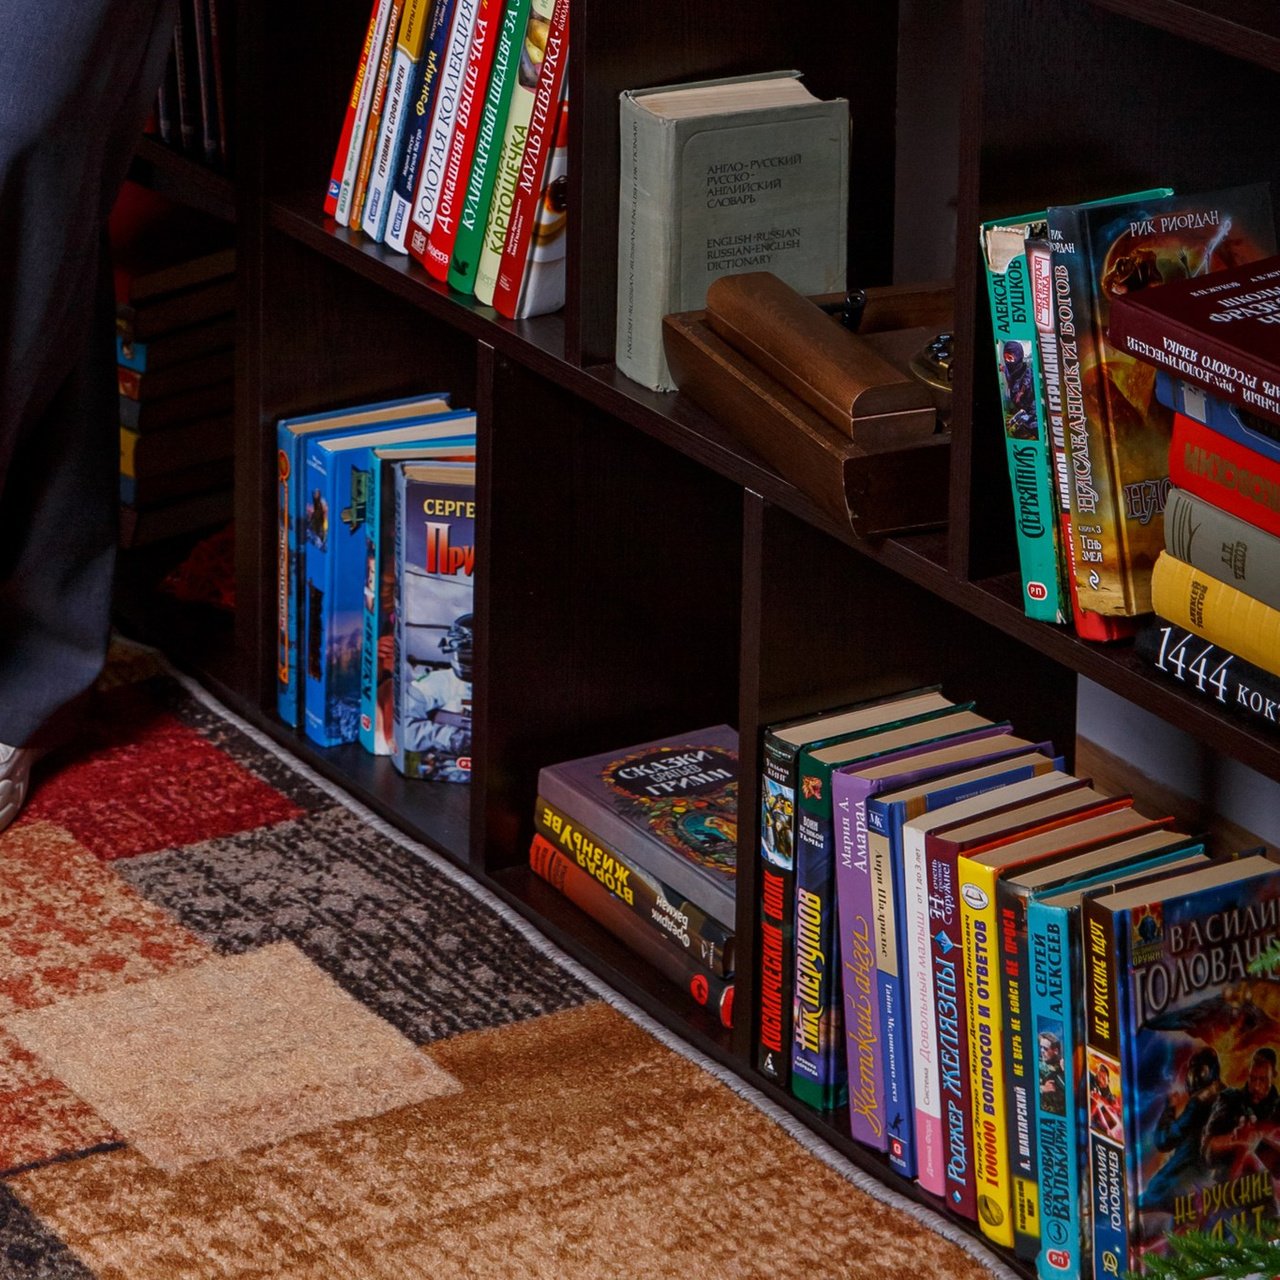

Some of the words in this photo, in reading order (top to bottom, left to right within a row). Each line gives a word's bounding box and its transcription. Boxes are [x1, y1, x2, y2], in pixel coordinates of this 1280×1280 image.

[394, 64, 406, 93] ЛОРЕН
[389, 95, 401, 125] СОФИ
[418, 129, 448, 226] ЗОЛОТАЯ
[438, 0, 474, 128] КОЛЛЕКЦИЯ
[462, 105, 498, 230] КУЛИНАРНЫЙ
[489, 33, 509, 108] ШЕДЕВР
[504, 10, 518, 35] ЗА
[519, 36, 562, 195] МУЛЬТИВАРКА
[378, 136, 392, 179] ГОТОВИМ
[707, 153, 802, 175] АНГЛО-РУССКИЙ
[707, 170, 756, 187] РУССКО-
[436, 132, 466, 235] Домашняя
[490, 124, 528, 256] КАРТОШЕЧКА
[706, 178, 782, 198] АНГЛИЙСКИЙ
[706, 193, 756, 209] СЛОВАРЬ
[706, 227, 801, 249] ENGLISH-RUSSIAN
[1129, 218, 1158, 238] РИК
[1161, 210, 1220, 235] РИОРДАН
[706, 239, 801, 261] RUSSIAN-ENGLISH
[706, 253, 773, 272] DICTIONARY
[1008, 260, 1027, 324] БУШКОВ
[1035, 256, 1044, 323] СЕКРЕТНАЯ
[1041, 274, 1050, 311] ПАПКА
[1054, 265, 1076, 337] БОГОВ
[1163, 336, 1198, 362] ЯЗЫКА
[1040, 333, 1062, 412] ГЕРМАНИИ
[1201, 356, 1257, 389] РУССКОГО
[1060, 337, 1099, 514] НАСЛЕДНИКИ
[1081, 551, 1103, 562] ЗМЕЯ
[1190, 580, 1201, 625] АЛЕКСЕЙ
[1197, 584, 1208, 629] ТОЛСТОЙ
[1155, 626, 1234, 704] 1444
[618, 749, 713, 781] СКАЗКИ
[644, 768, 733, 797] ГРИММ
[650, 765, 703, 784] БРАТЬЕВ
[838, 796, 851, 812] А.
[869, 813, 883, 829] МК
[542, 807, 575, 852] УВЕ
[799, 833, 824, 849] ТЬМЫ
[840, 815, 854, 869] Мария
[853, 801, 869, 874] Амарал
[573, 831, 631, 885] ЖИЗНЬ
[575, 849, 634, 906] ВТОРАЯ
[655, 895, 689, 930] Бакман
[763, 870, 785, 920] ВОЛК
[796, 887, 824, 1007] ПЕРУМОВ
[1002, 908, 1018, 955] ПРОСИ
[1089, 919, 1106, 950] ИДУТ
[974, 920, 989, 1000] ОТВЕТОВ
[1007, 960, 1019, 976] НЕ
[1034, 933, 1048, 997] СЕРГЕЙ
[1048, 922, 1064, 1015] АЛЕКСЕЕВ
[1091, 951, 1109, 1014] РУССКИЕ
[761, 922, 783, 1052] КОСМИЧЕСКИЙ
[1010, 980, 1020, 1015] БОЙСЯ
[935, 955, 963, 1098] ЖЕЛЯЗНЫ
[1013, 1017, 1022, 1035] НЕ
[1095, 1016, 1111, 1039] НЕ
[847, 994, 883, 1138] Жестокий
[978, 1023, 996, 1117] ВОПРОСОВ
[1013, 1037, 1023, 1062] ВЕРЬ
[1015, 1063, 1024, 1077] НЕ
[946, 1099, 967, 1186] РОДЖЕР
[1015, 1086, 1031, 1153] ШАНТАРСКИЙ
[1020, 1154, 1032, 1171] А.
[1043, 1118, 1056, 1217] СОКРОВИЩА
[1052, 1120, 1069, 1222] ВАЛЬКИРИИ
[1097, 1145, 1109, 1216] ВАСИЛИЙ
[1108, 1151, 1123, 1232] ГОЛОВАЧЕВ
[1174, 1194, 1196, 1225] НЕ
[1203, 1172, 1272, 1211] РУССКИЕ
